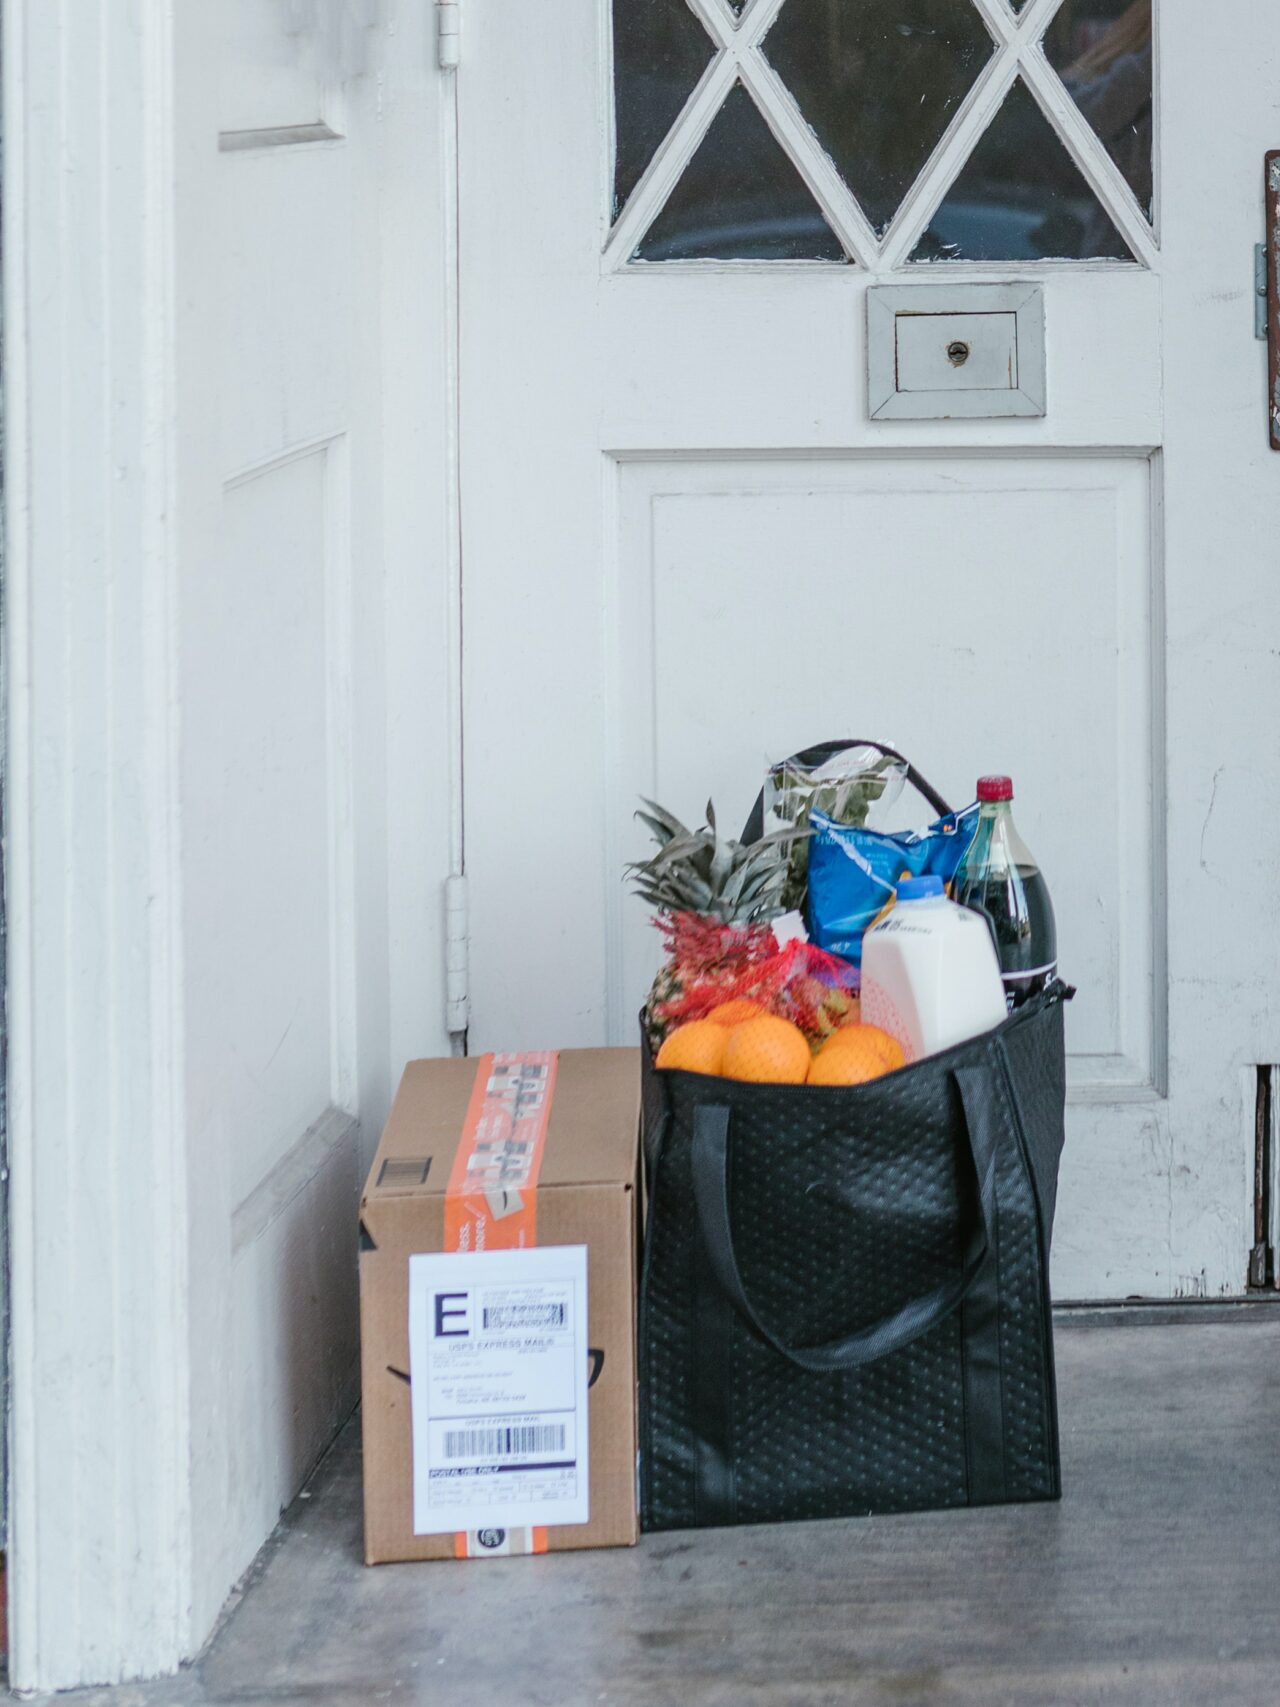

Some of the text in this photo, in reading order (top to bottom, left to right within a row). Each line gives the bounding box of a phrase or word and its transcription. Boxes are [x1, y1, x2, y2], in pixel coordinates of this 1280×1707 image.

[434, 1292, 469, 1338] E
[448, 1342, 474, 1353] USPS
[477, 1340, 521, 1351] EXPRESS
